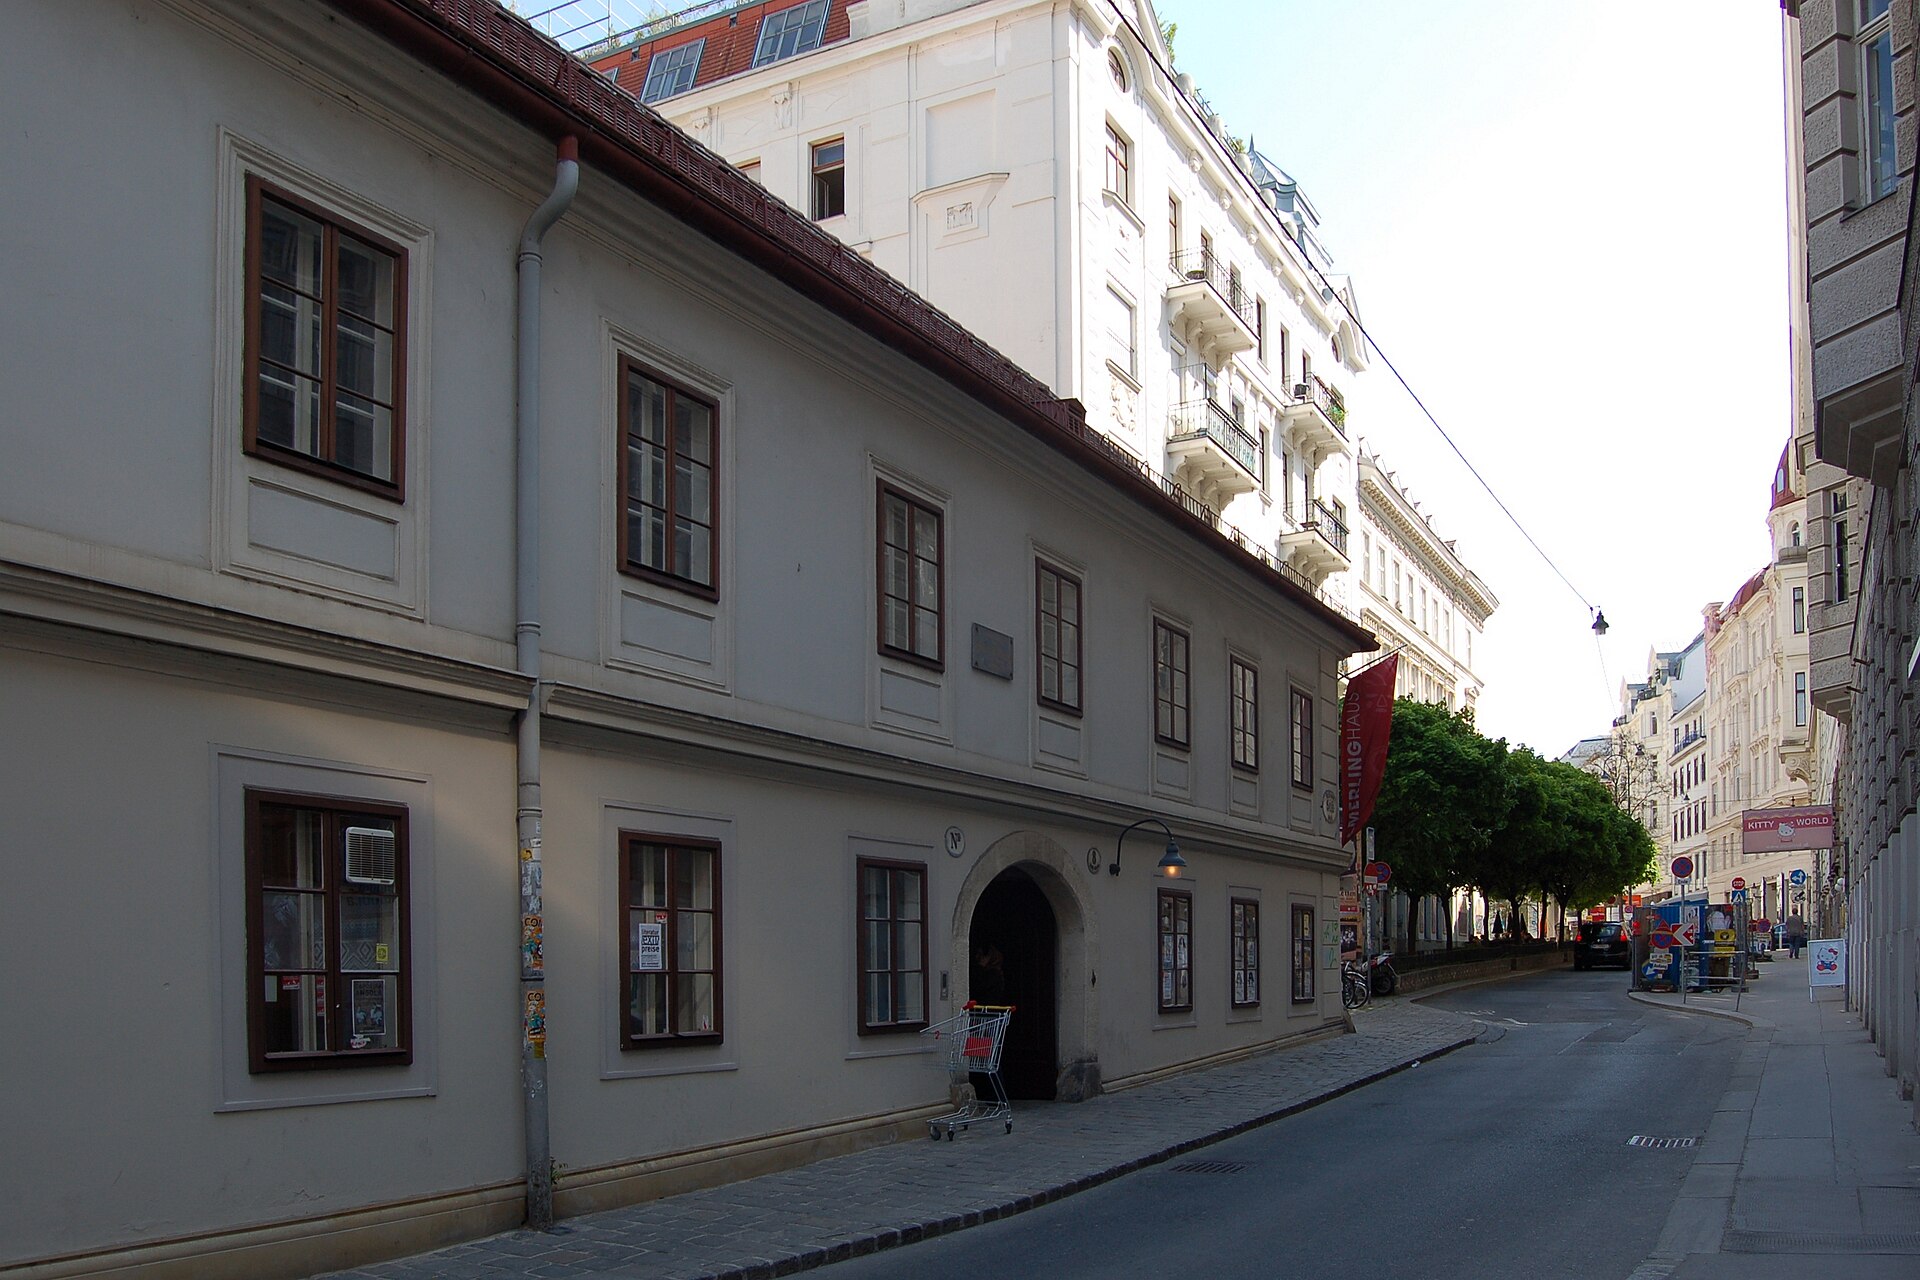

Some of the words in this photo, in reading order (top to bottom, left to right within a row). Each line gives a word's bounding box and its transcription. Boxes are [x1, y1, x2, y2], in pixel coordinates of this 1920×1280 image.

[1748, 820, 1775, 829] KITTY
[1796, 817, 1829, 826] WORLD
[641, 946, 659, 954] preise
